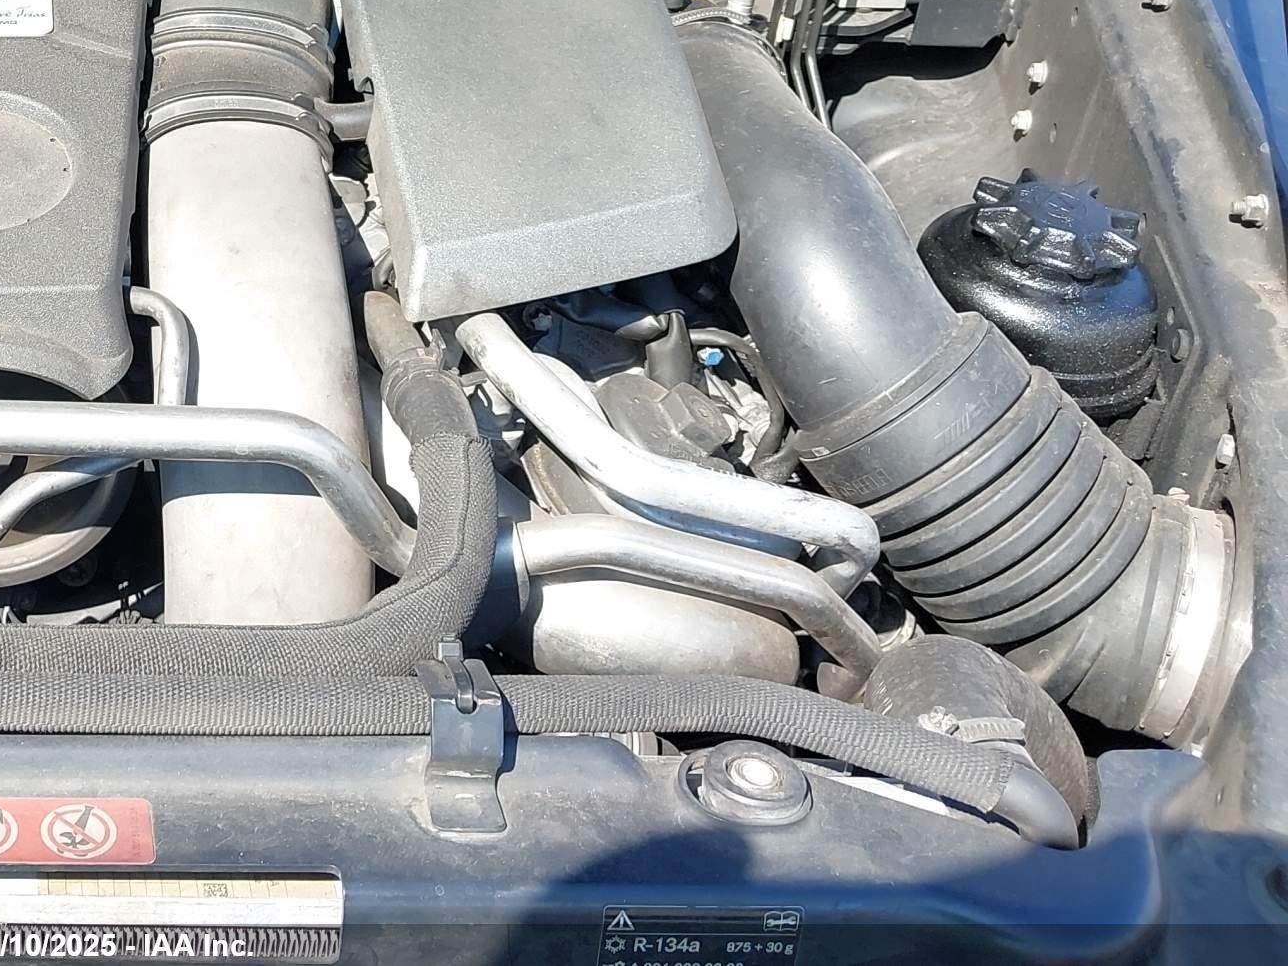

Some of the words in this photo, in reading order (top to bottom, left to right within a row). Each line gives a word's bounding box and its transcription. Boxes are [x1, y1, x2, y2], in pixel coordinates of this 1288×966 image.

[633, 937, 701, 952] R-134a
[726, 941, 751, 952] 875
[766, 941, 783, 952] 30
